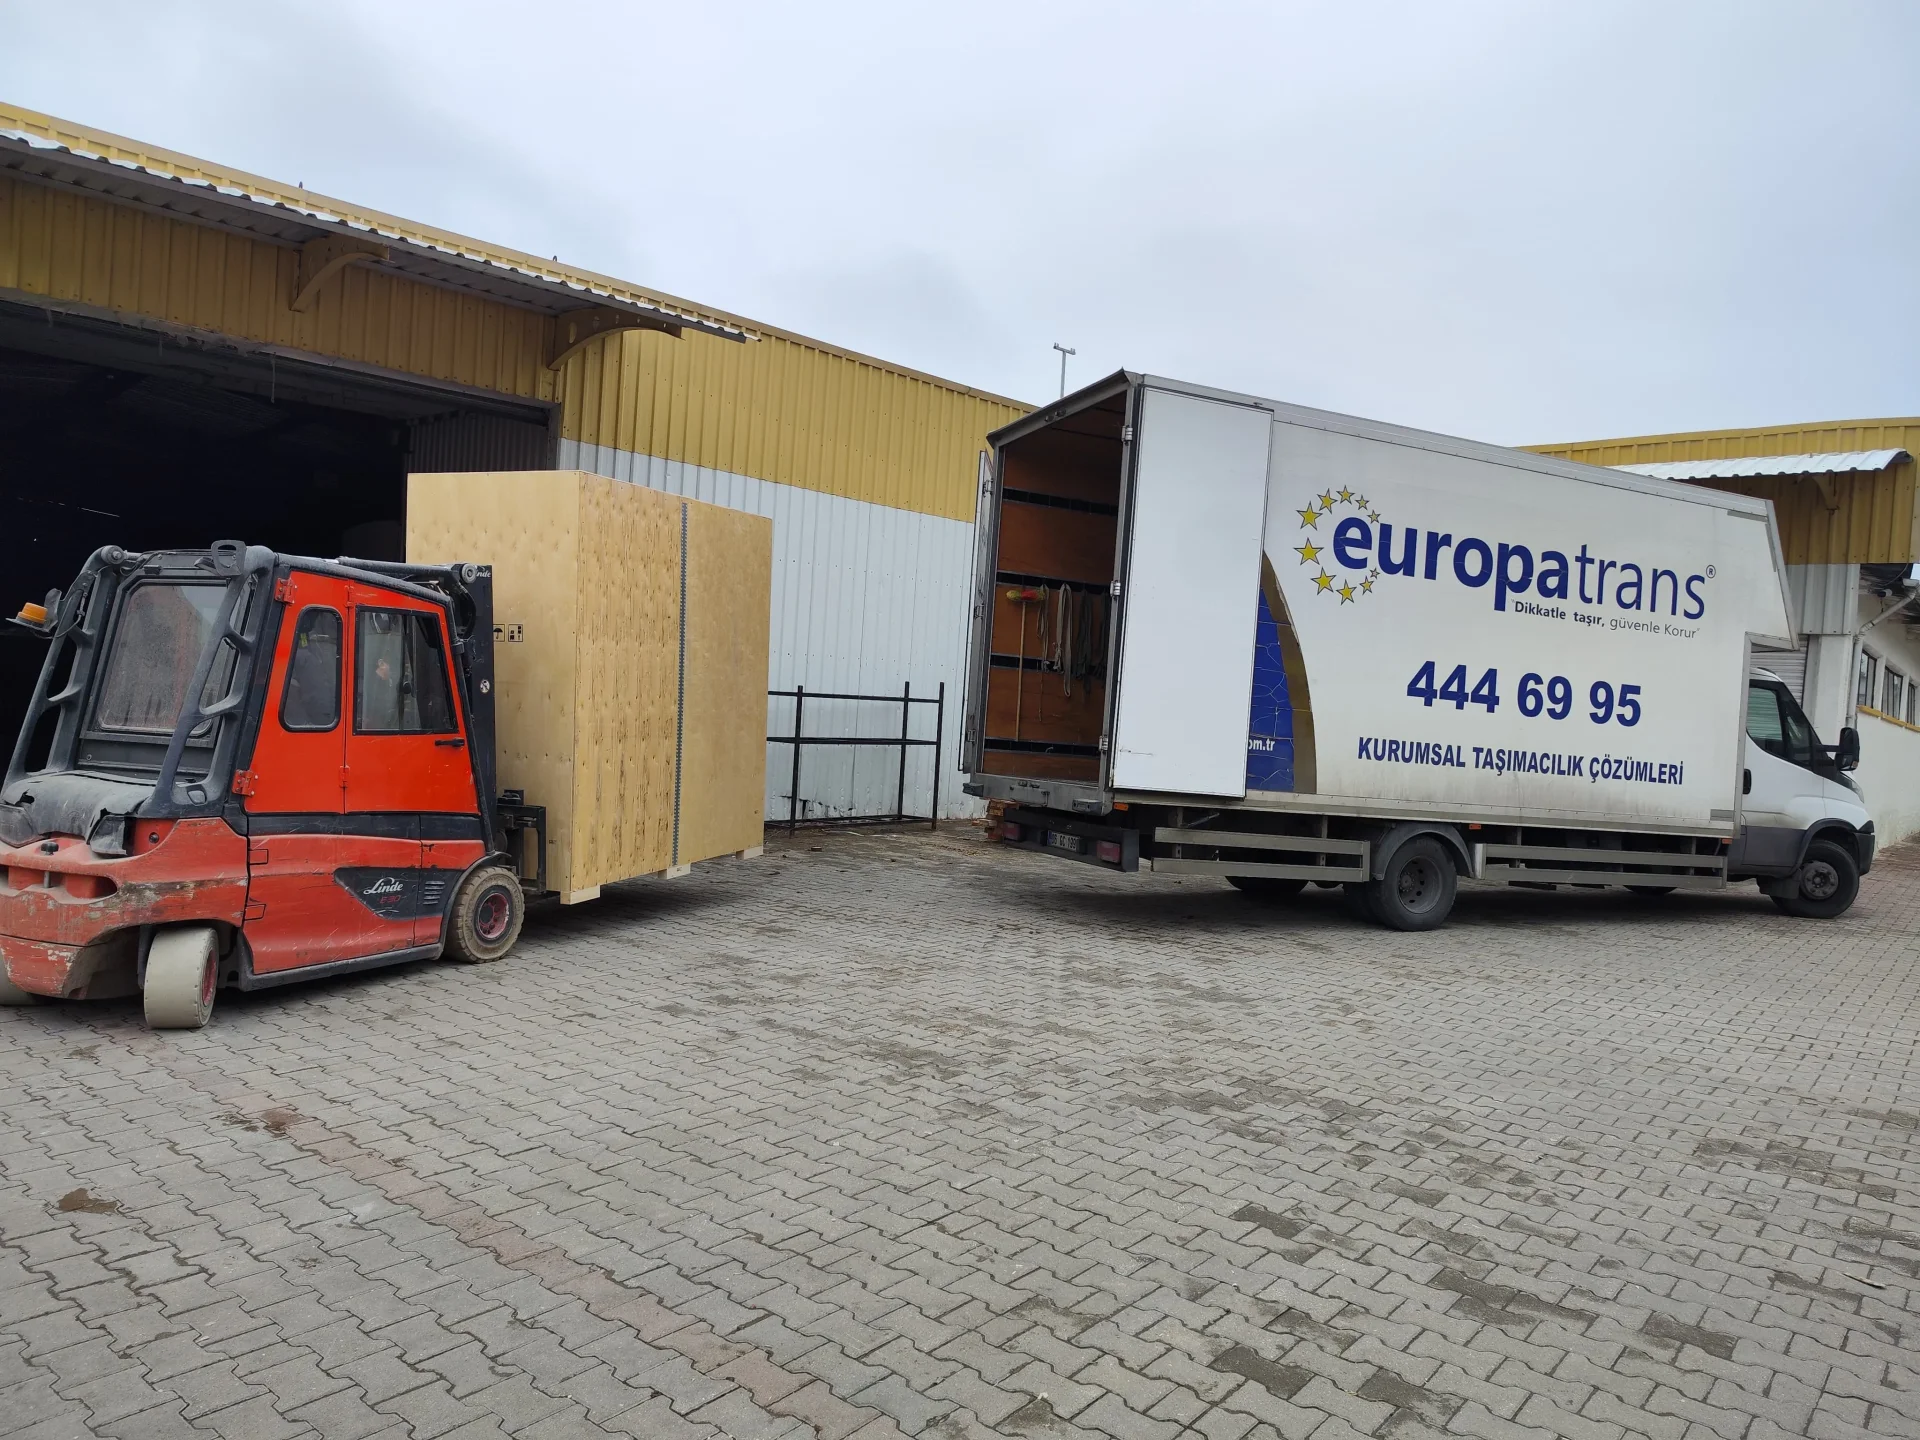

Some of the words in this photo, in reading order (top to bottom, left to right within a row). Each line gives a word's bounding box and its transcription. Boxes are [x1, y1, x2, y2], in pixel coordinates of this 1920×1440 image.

[1573, 611, 1605, 627] taşır,
[1610, 617, 1661, 634] güvenle
[1406, 660, 1501, 714] 444
[1517, 672, 1574, 721] 69
[1589, 680, 1642, 728] 95
[1357, 736, 1466, 768] KURUMSAL
[1472, 746, 1584, 776] TAŞIMACILIK
[1589, 755, 1684, 785] ÇÖZÜMLERİ
[363, 876, 404, 895] Linde
